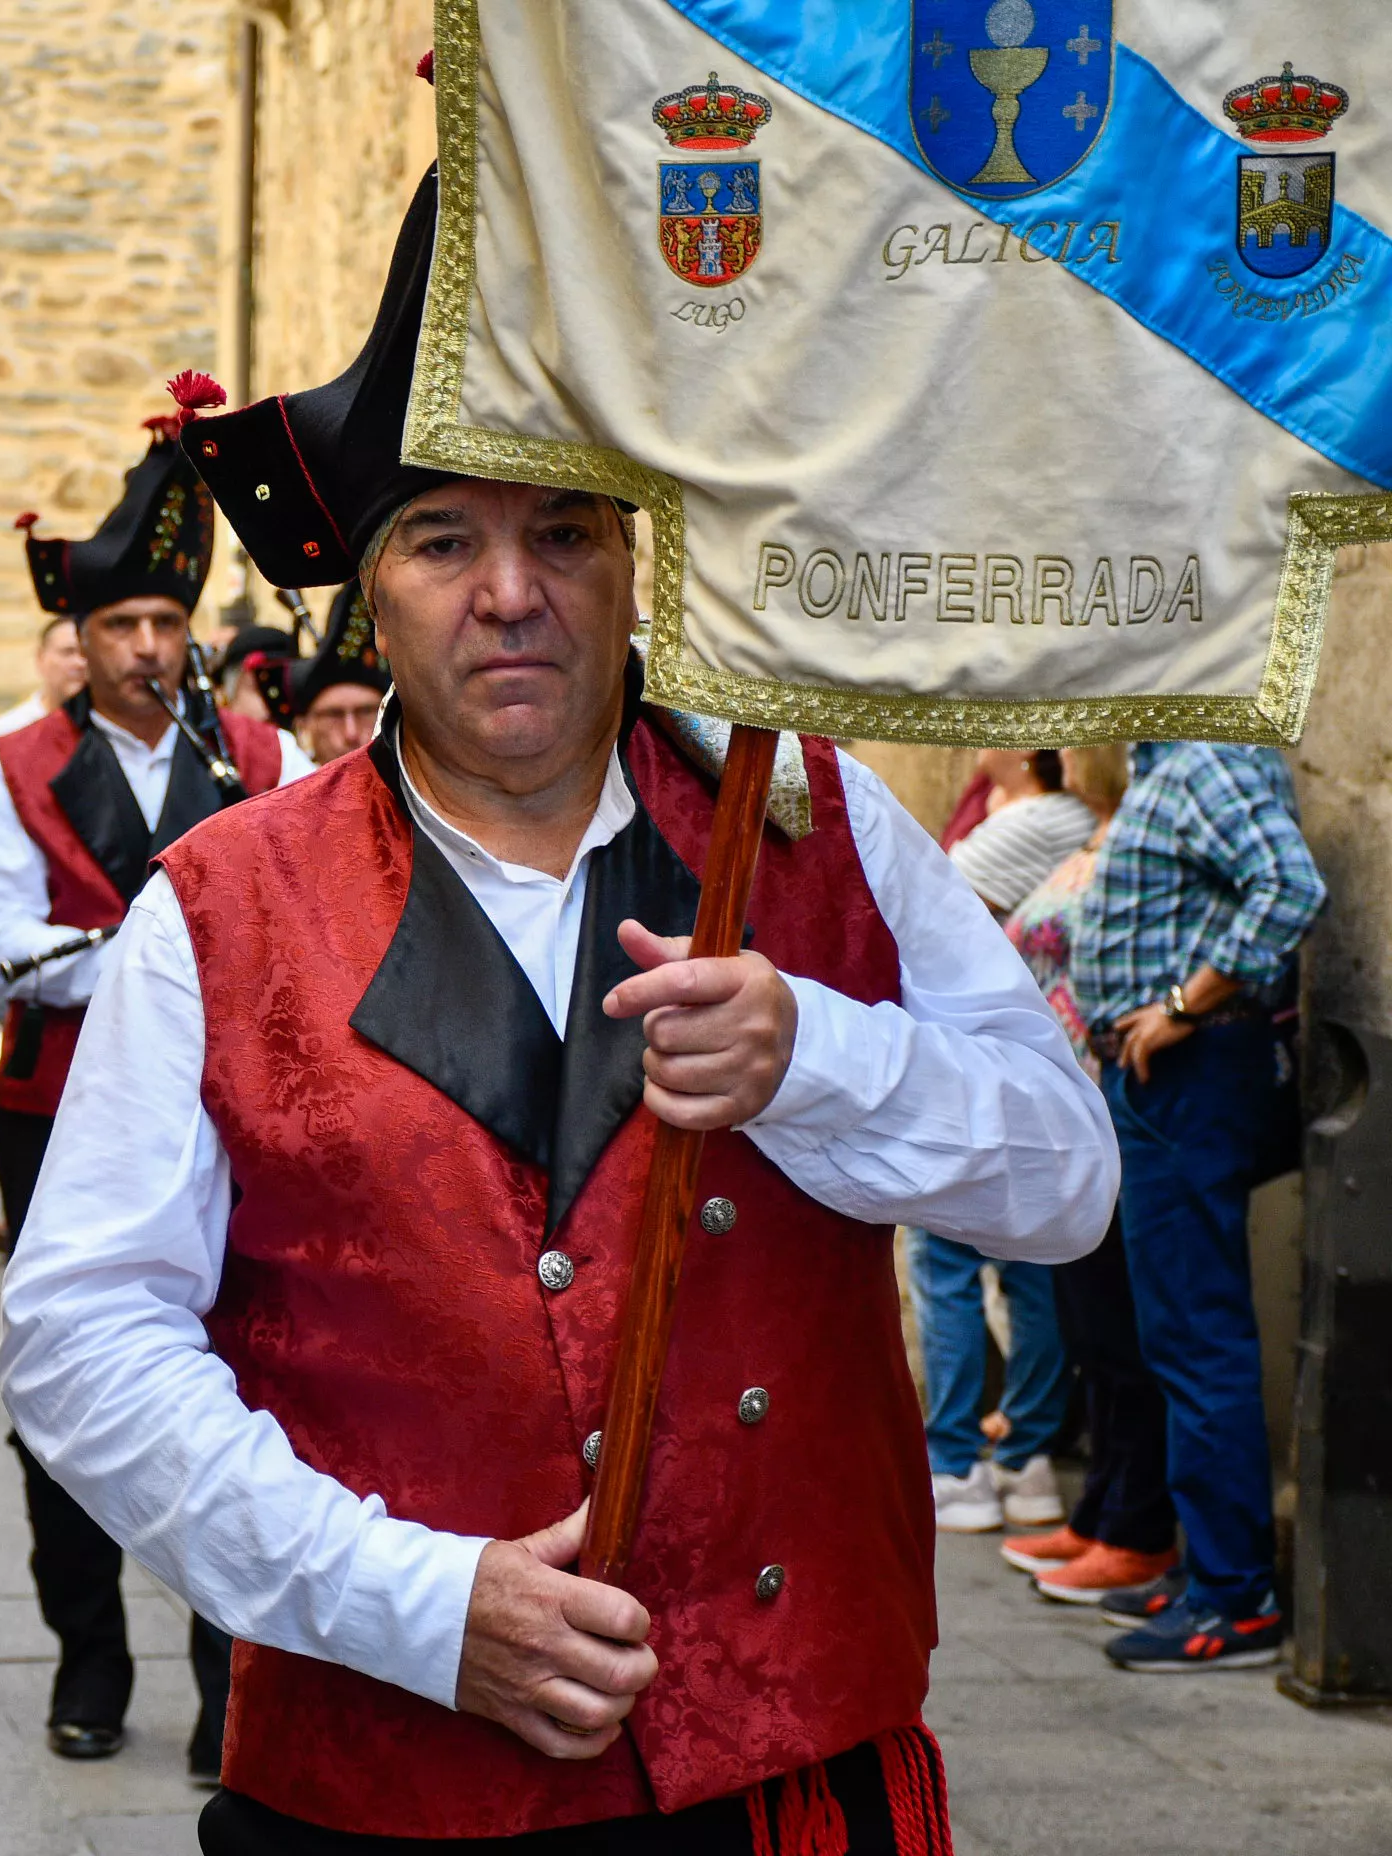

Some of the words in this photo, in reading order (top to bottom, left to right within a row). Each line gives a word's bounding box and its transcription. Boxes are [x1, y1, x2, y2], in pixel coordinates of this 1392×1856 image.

[882, 220, 1122, 281] GALICIA
[669, 297, 746, 334] LUGO
[752, 541, 1203, 626] PONFERRADA
